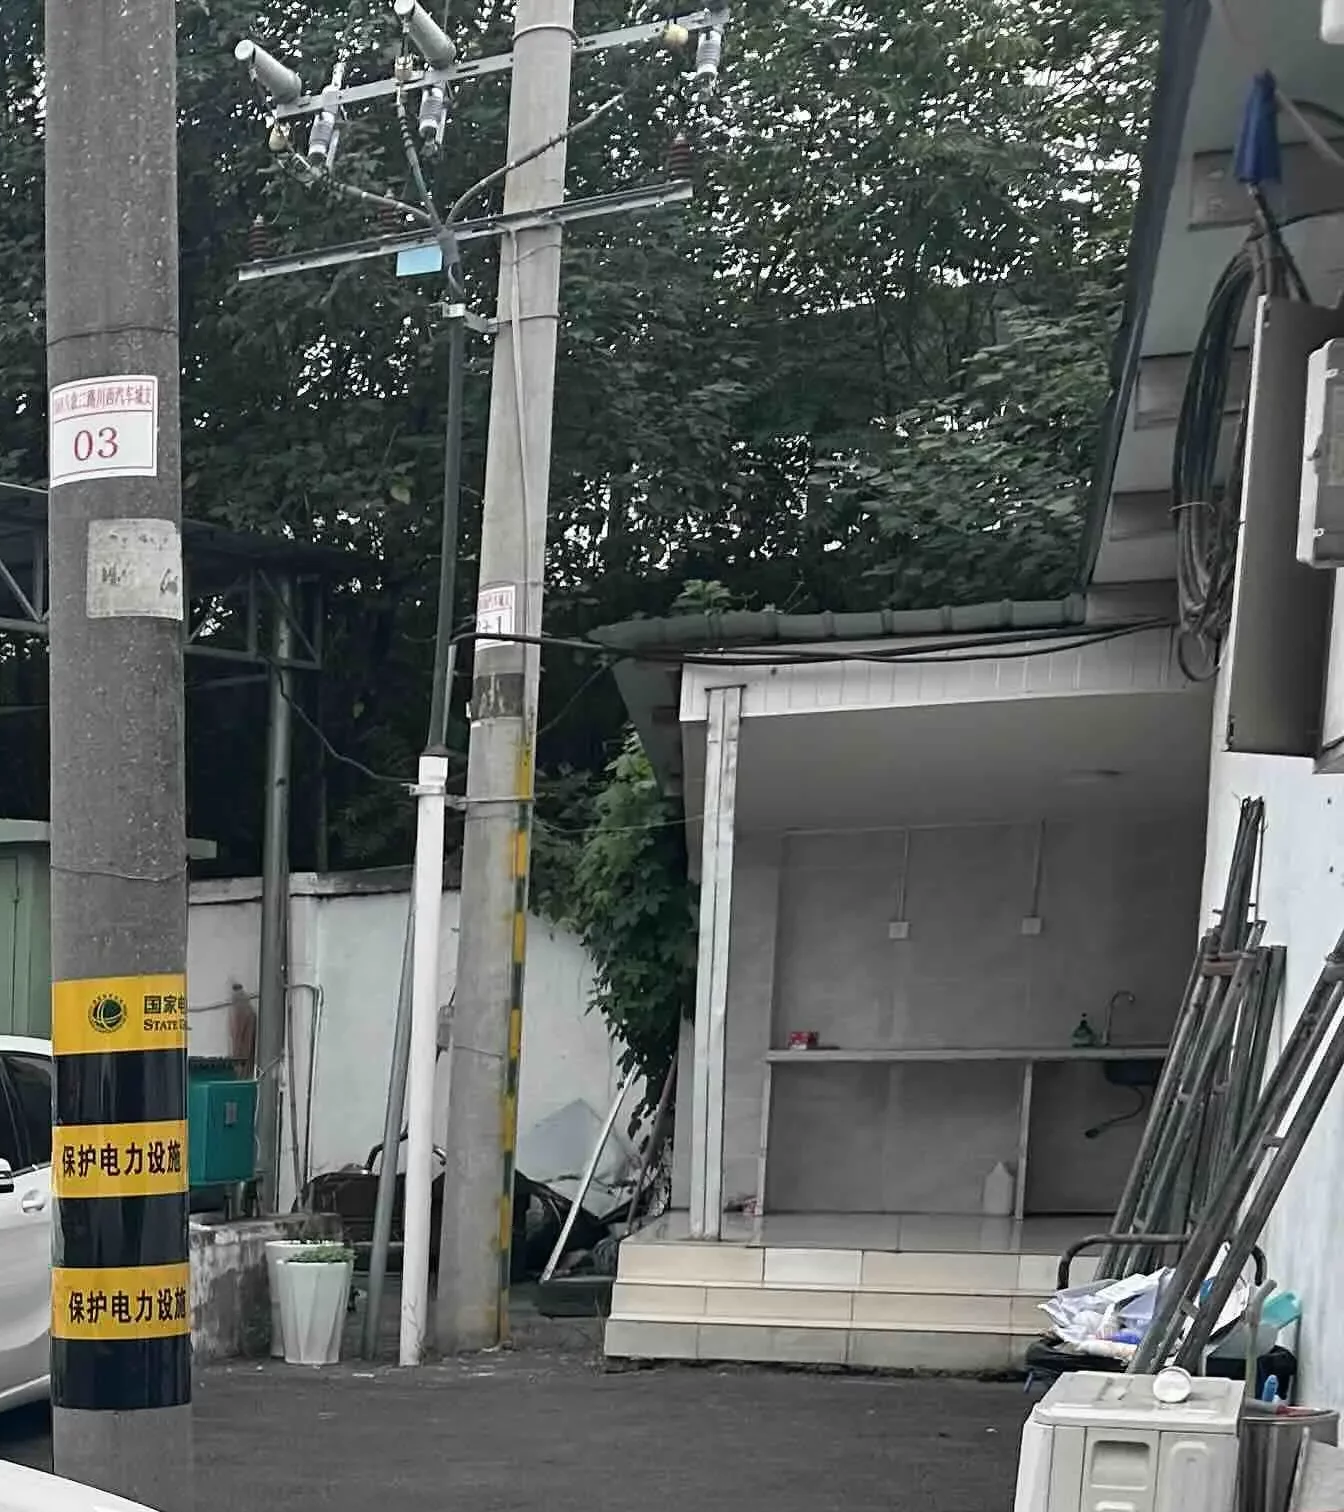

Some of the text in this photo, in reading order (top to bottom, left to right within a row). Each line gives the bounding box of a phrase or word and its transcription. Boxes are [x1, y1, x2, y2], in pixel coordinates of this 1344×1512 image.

[73, 426, 120, 462] 03
[62, 1139, 181, 1177] 保护电力设施
[69, 1285, 186, 1324] 保护电力设施
